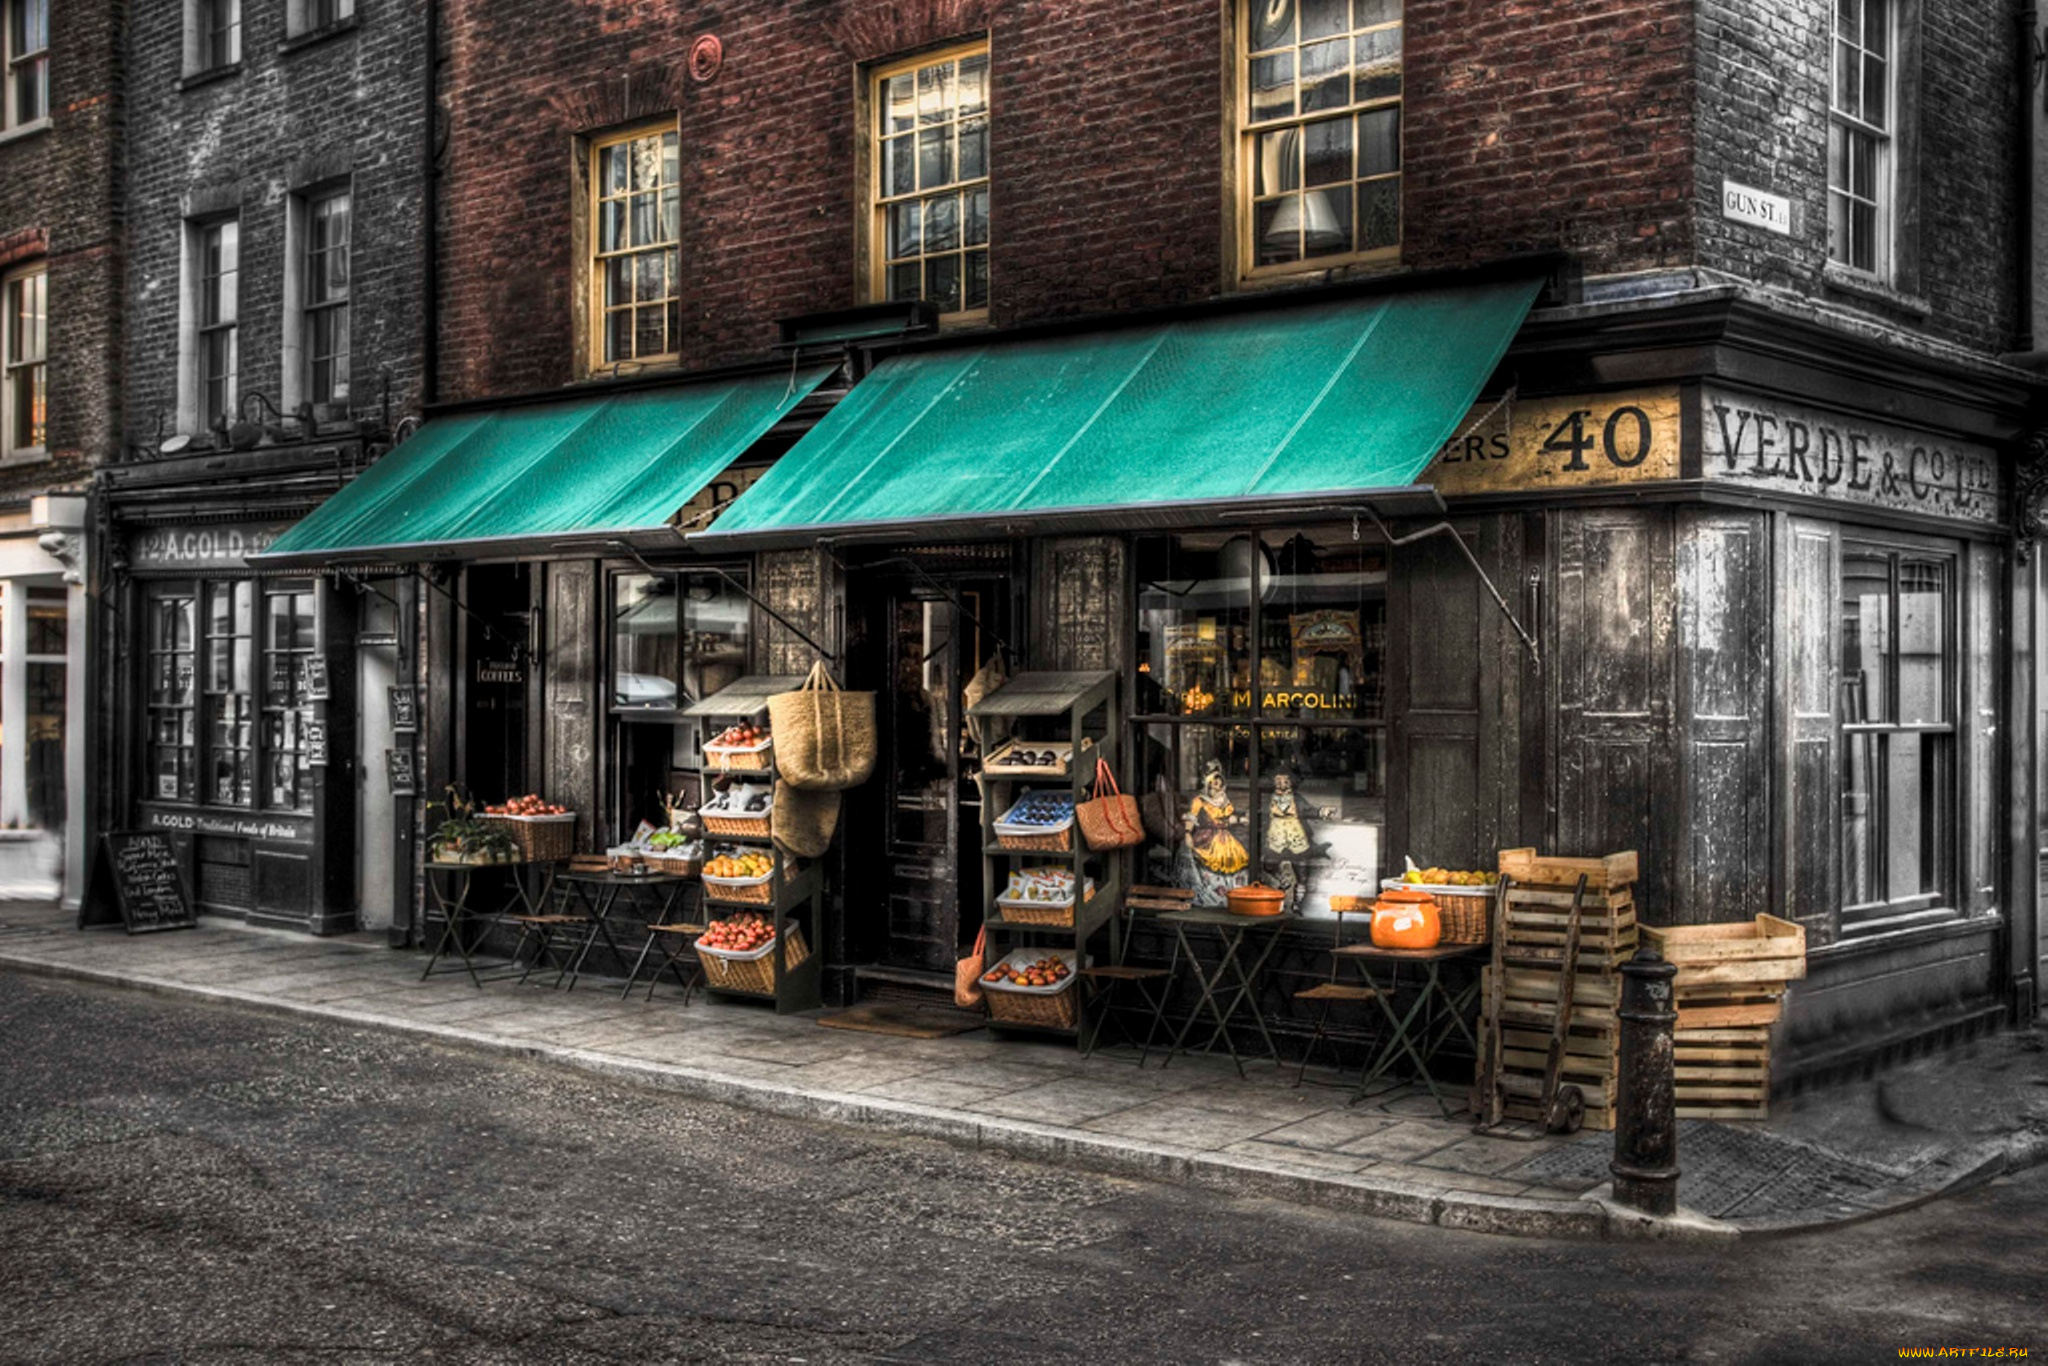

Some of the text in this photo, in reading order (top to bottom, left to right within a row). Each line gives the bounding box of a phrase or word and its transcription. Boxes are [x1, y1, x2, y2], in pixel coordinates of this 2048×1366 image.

[1726, 190, 1757, 215] GUN
[1536, 405, 1652, 473] 40
[1713, 403, 1873, 492] VERDE
[1881, 450, 1900, 498] &
